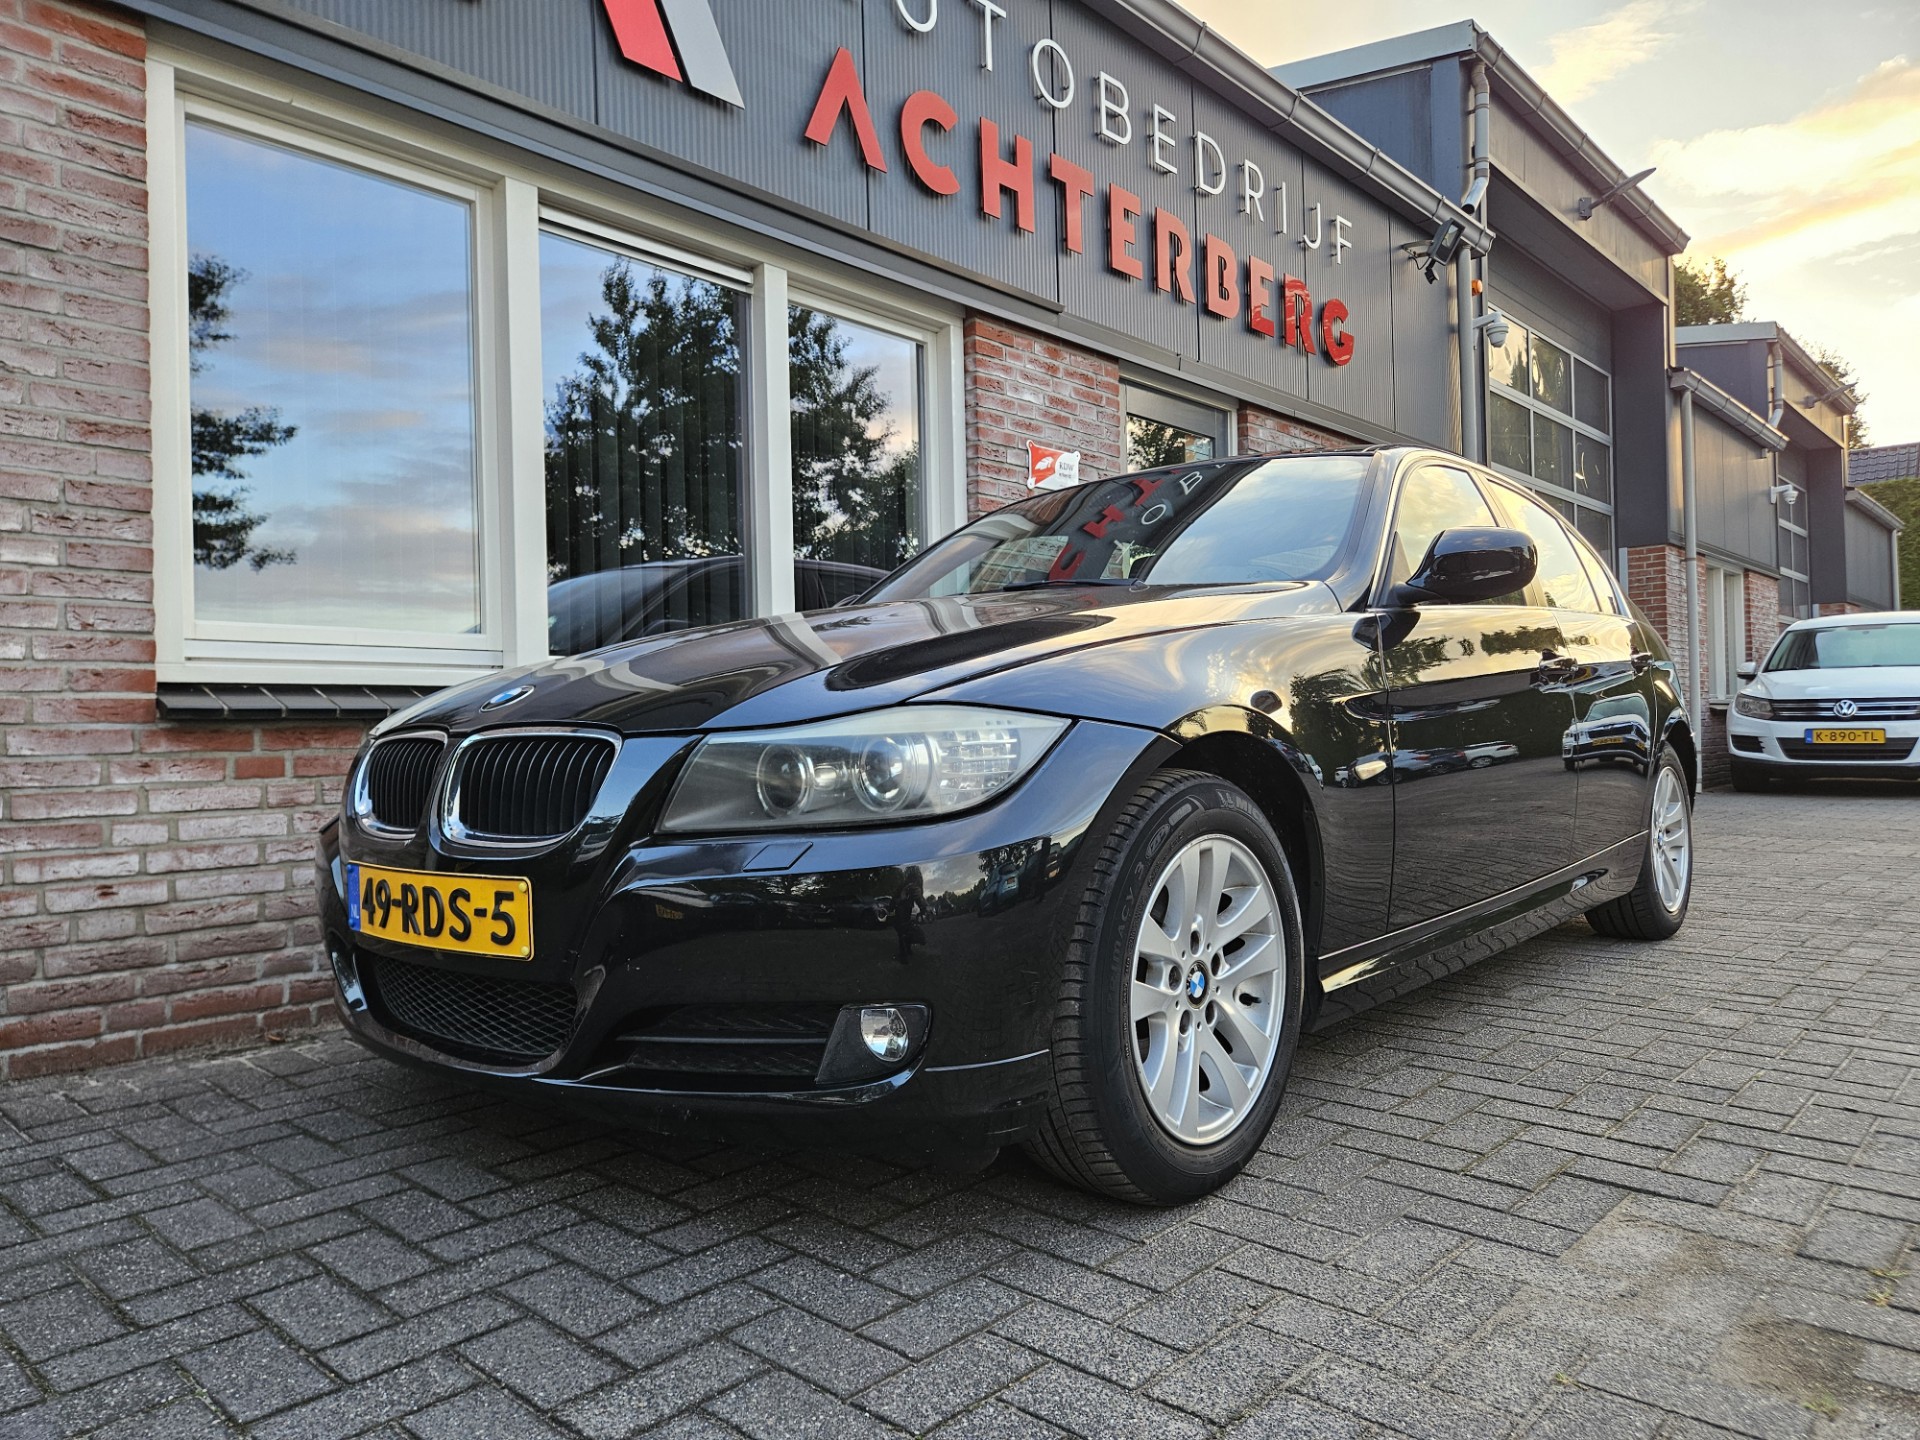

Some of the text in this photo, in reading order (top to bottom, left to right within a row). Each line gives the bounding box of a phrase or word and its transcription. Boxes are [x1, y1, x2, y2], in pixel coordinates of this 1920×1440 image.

[805, 46, 1355, 366] ACHTERBERG
[1815, 731, 1878, 742] K-890-TL
[361, 877, 516, 946] 49-RDS-5
